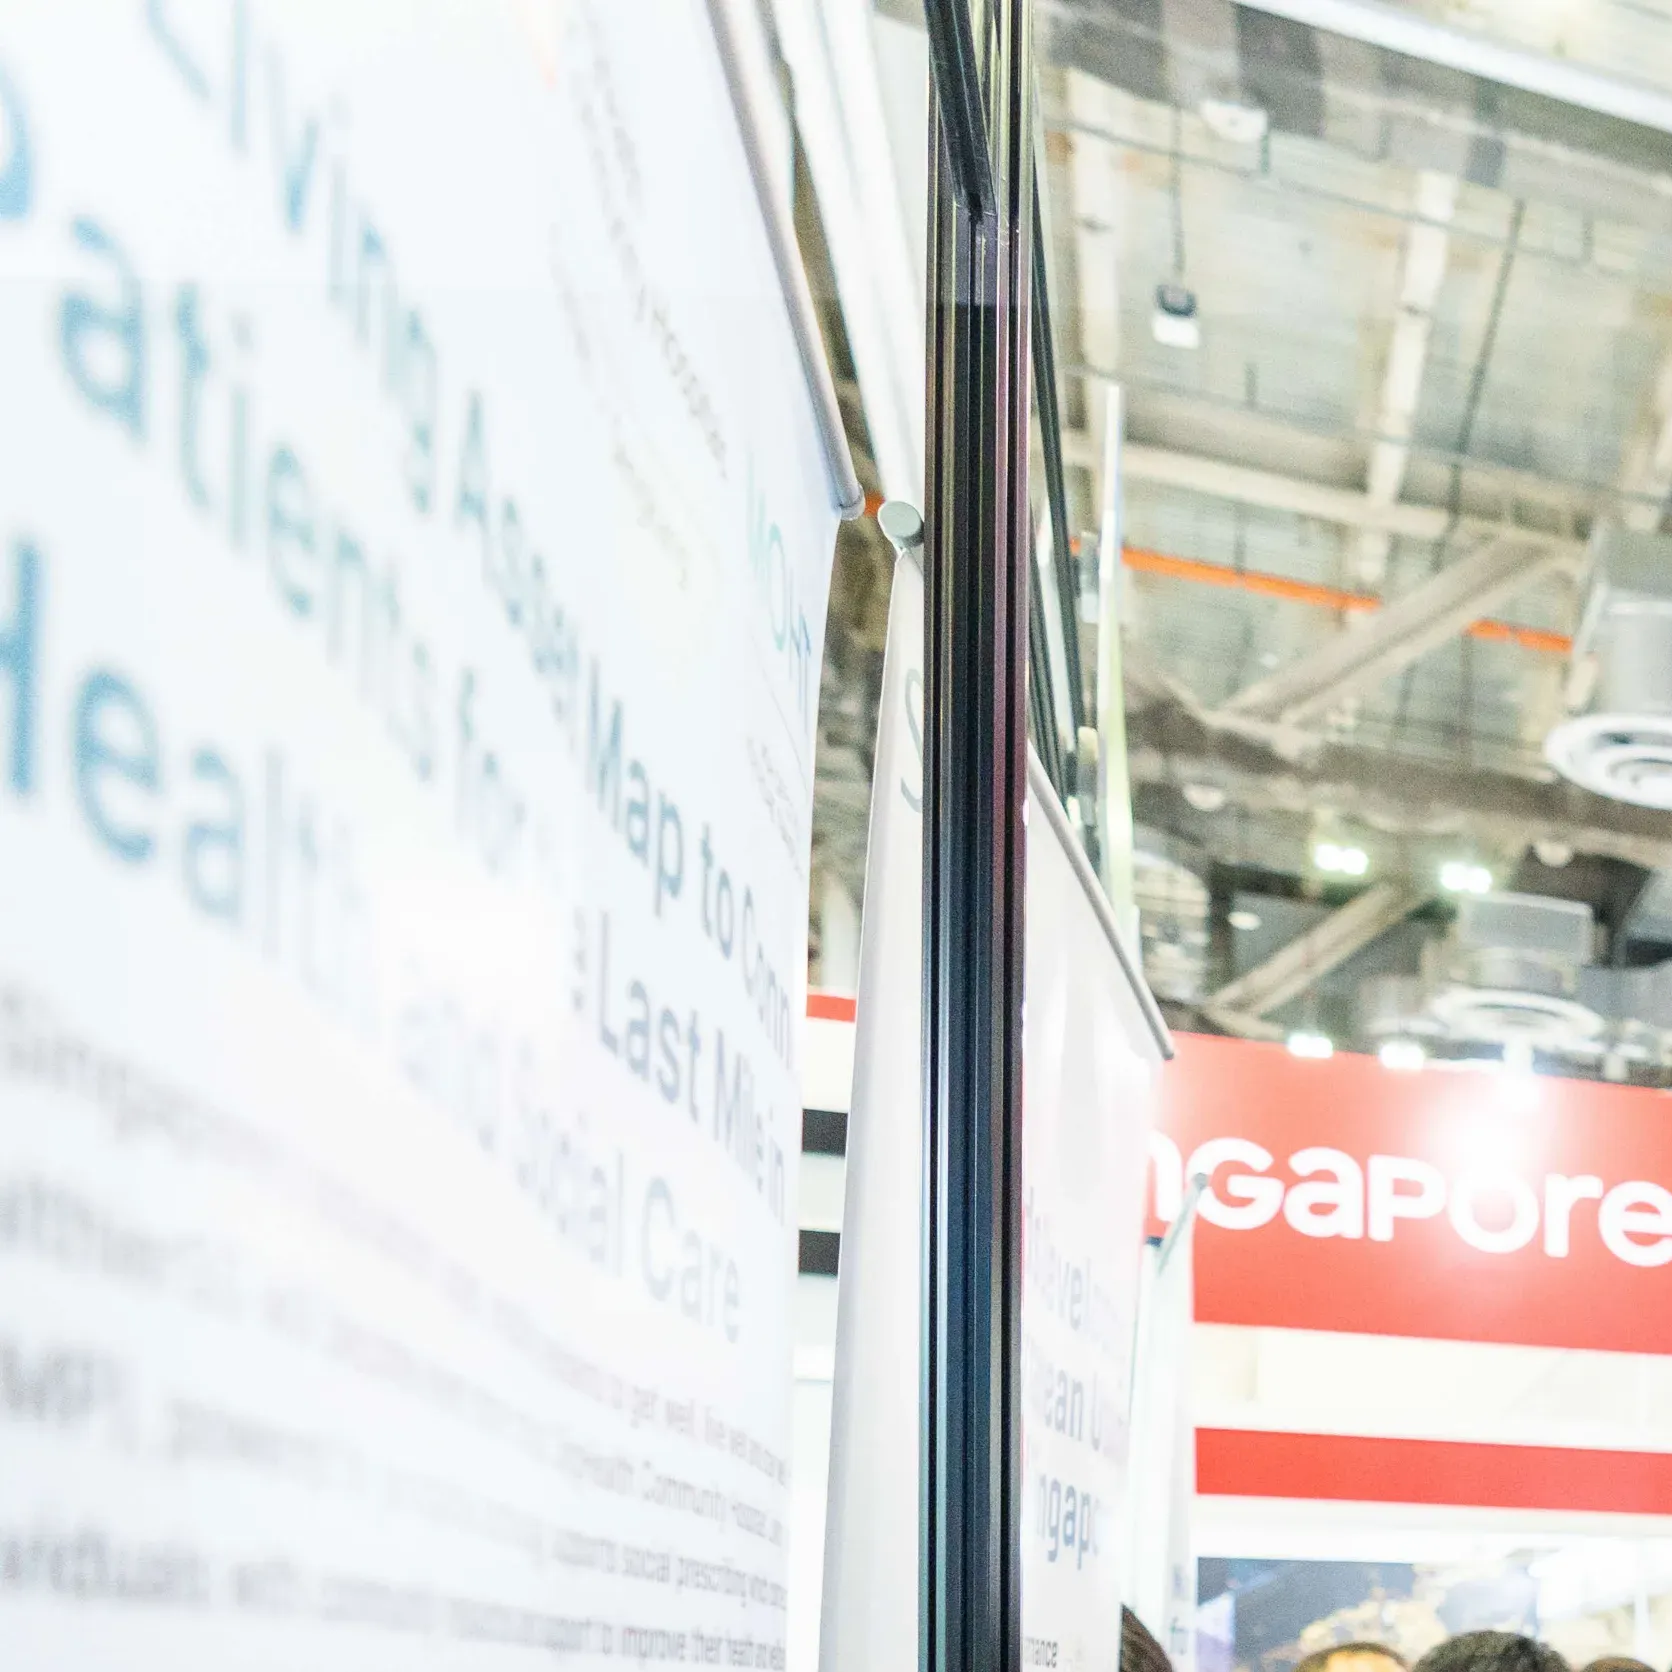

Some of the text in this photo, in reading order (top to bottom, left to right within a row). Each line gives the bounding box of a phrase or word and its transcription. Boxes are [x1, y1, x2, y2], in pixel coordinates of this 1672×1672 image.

[585, 652, 686, 920] Map
[698, 820, 738, 960] to
[598, 910, 702, 1126] Last
[713, 1028, 767, 1195] Mile
[641, 1174, 742, 1346] Care
